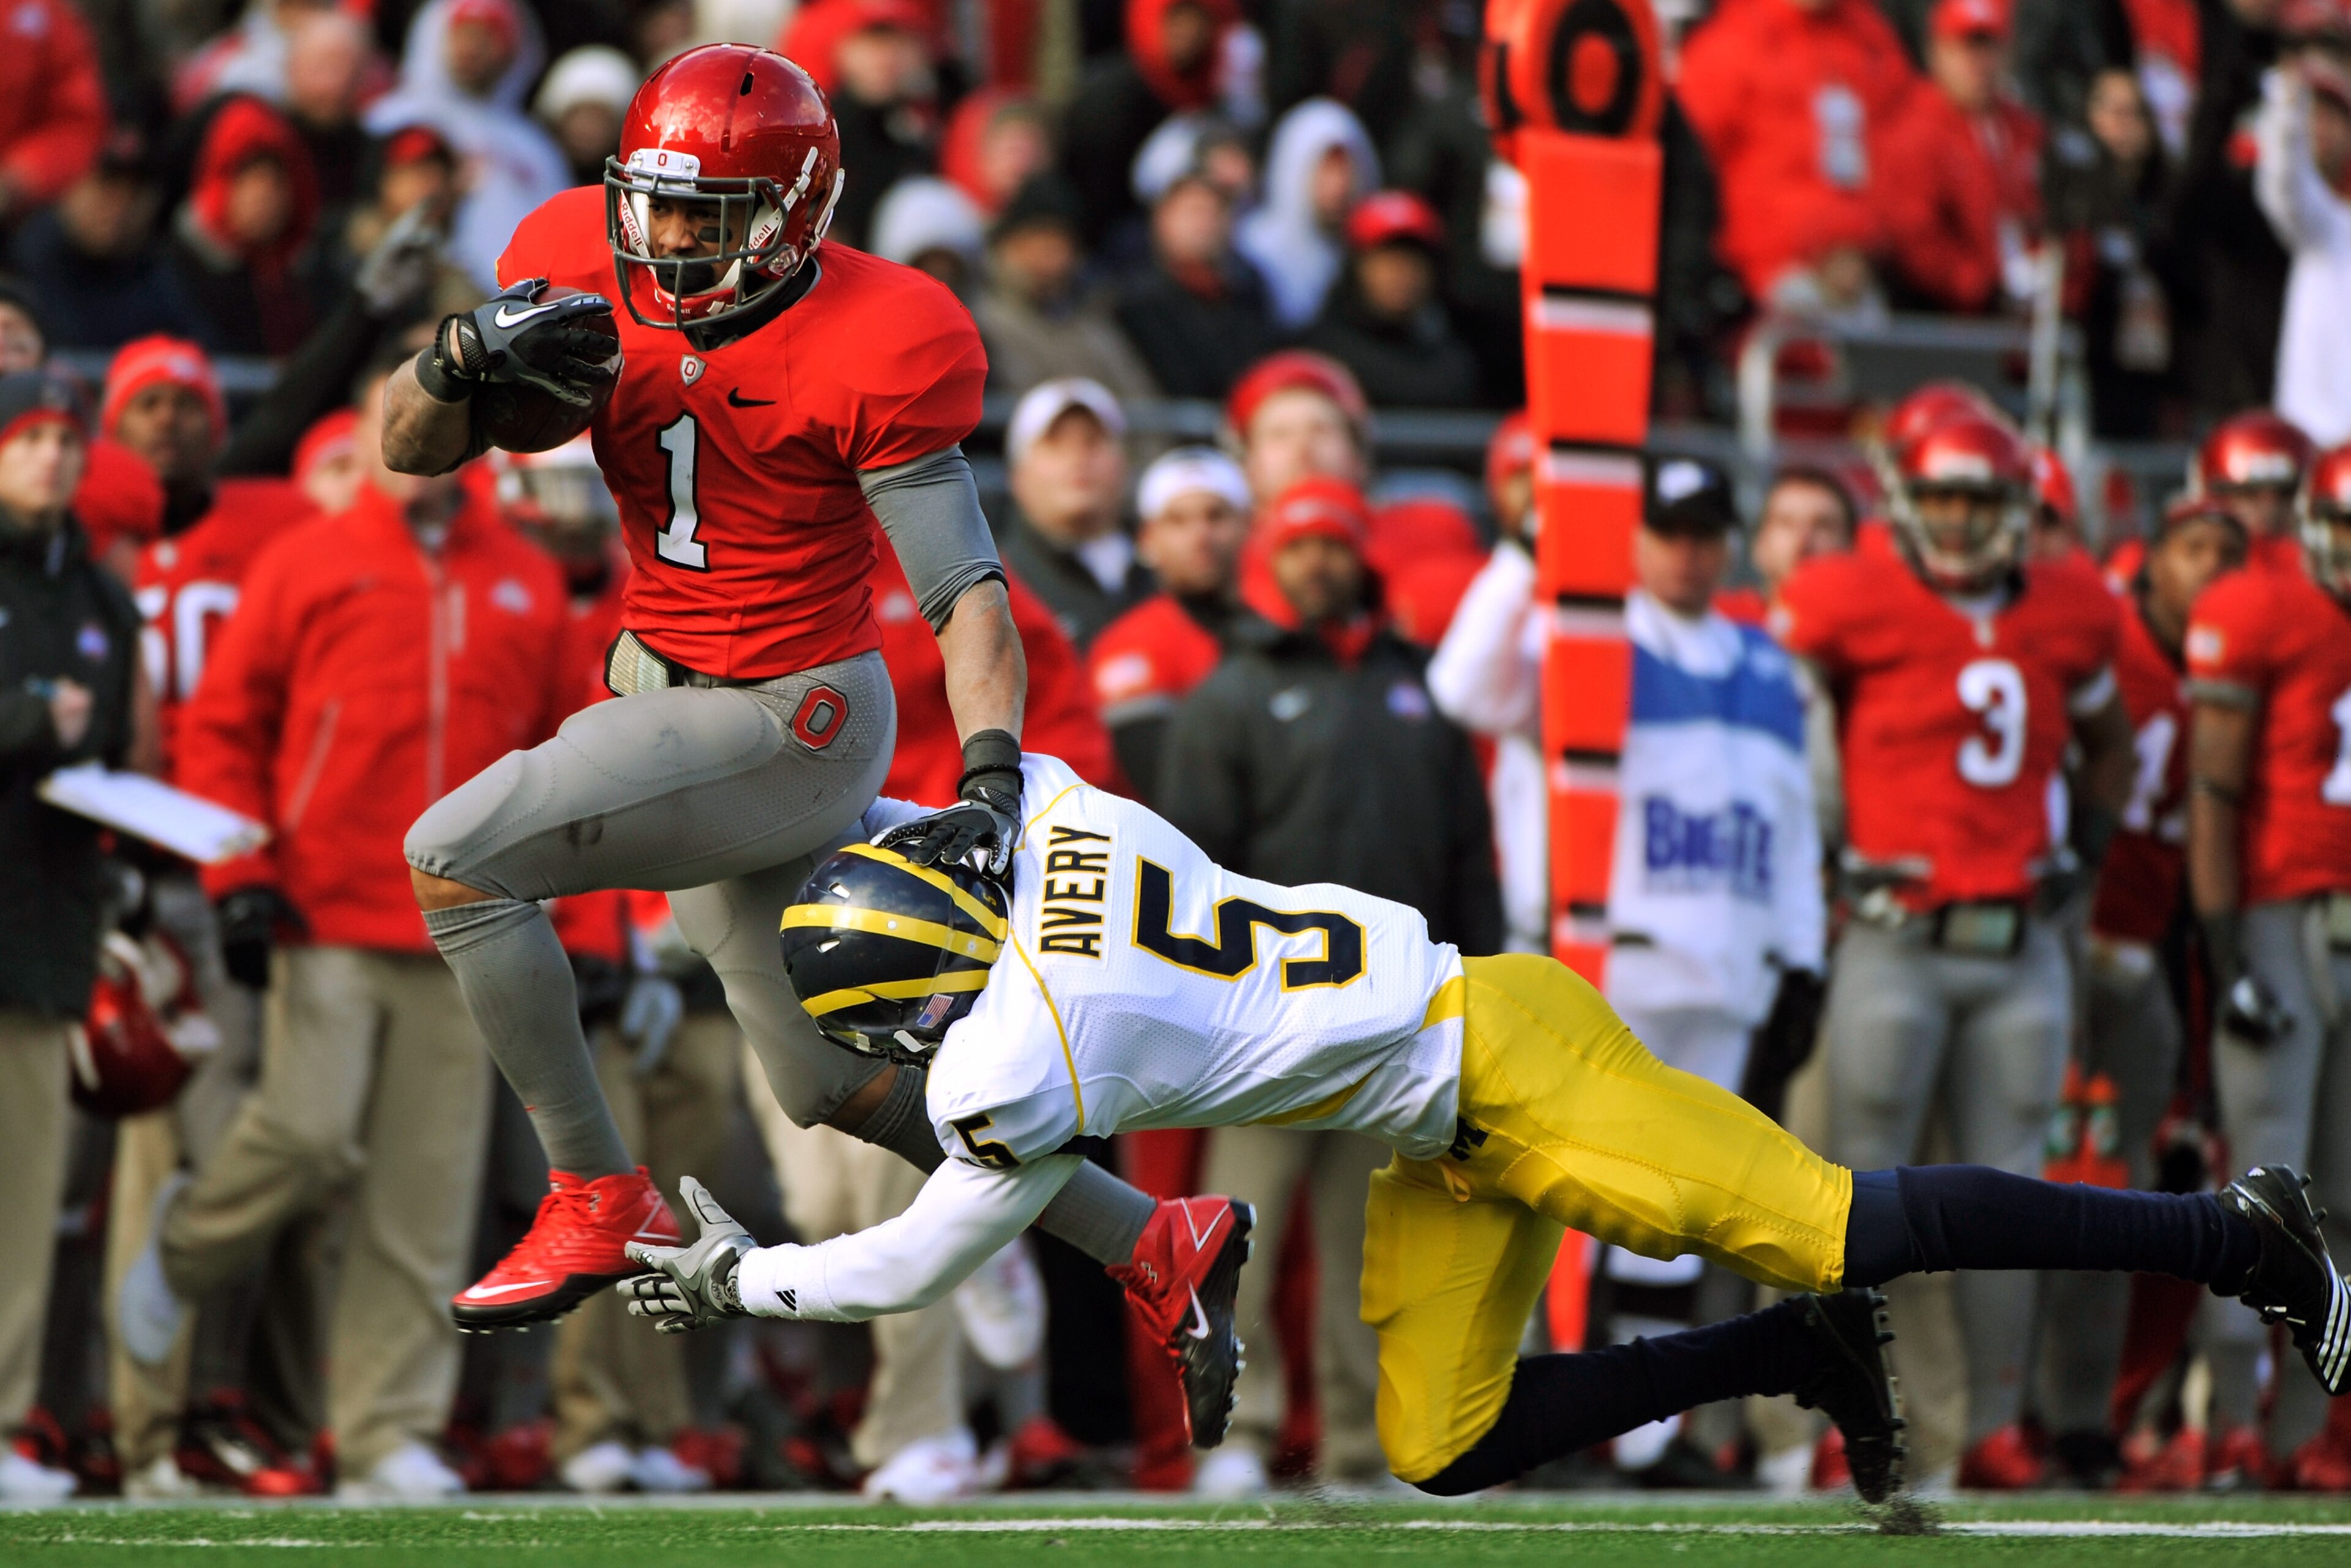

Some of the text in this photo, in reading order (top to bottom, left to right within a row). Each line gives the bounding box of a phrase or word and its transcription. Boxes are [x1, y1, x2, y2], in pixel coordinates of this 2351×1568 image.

[621, 203, 643, 246] Riddell
[655, 408, 711, 574] 1
[1956, 656, 2027, 788] 3
[1038, 825, 1112, 960] AVERY
[1131, 854, 1367, 992] 5
[949, 1111, 1024, 1169] 5
